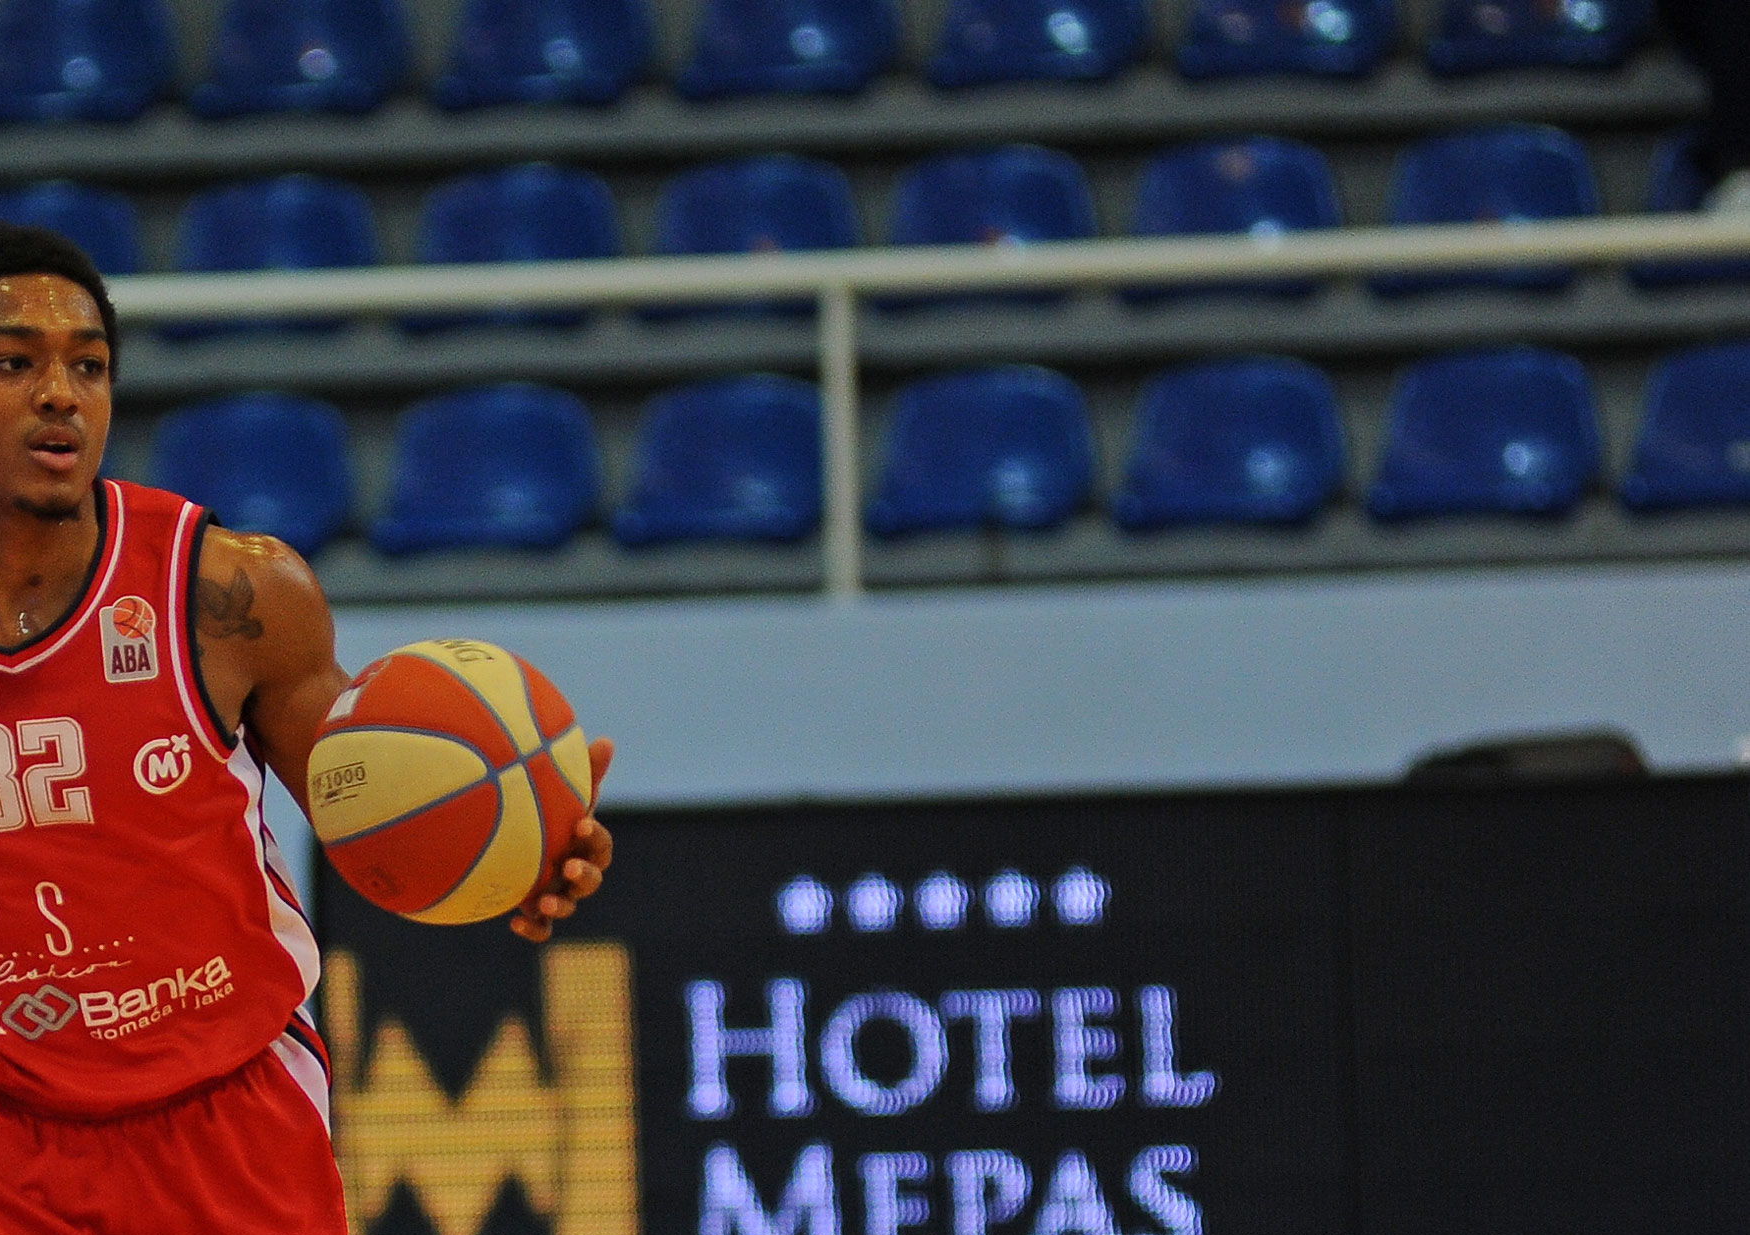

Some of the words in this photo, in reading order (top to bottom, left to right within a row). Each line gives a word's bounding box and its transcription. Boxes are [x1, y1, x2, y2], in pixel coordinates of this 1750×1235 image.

[111, 642, 151, 675] ABA
[79, 956, 232, 1027] Banka
[90, 1003, 173, 1040] domaća
[194, 982, 235, 1010] jaka
[686, 976, 1219, 1119] HOTEL
